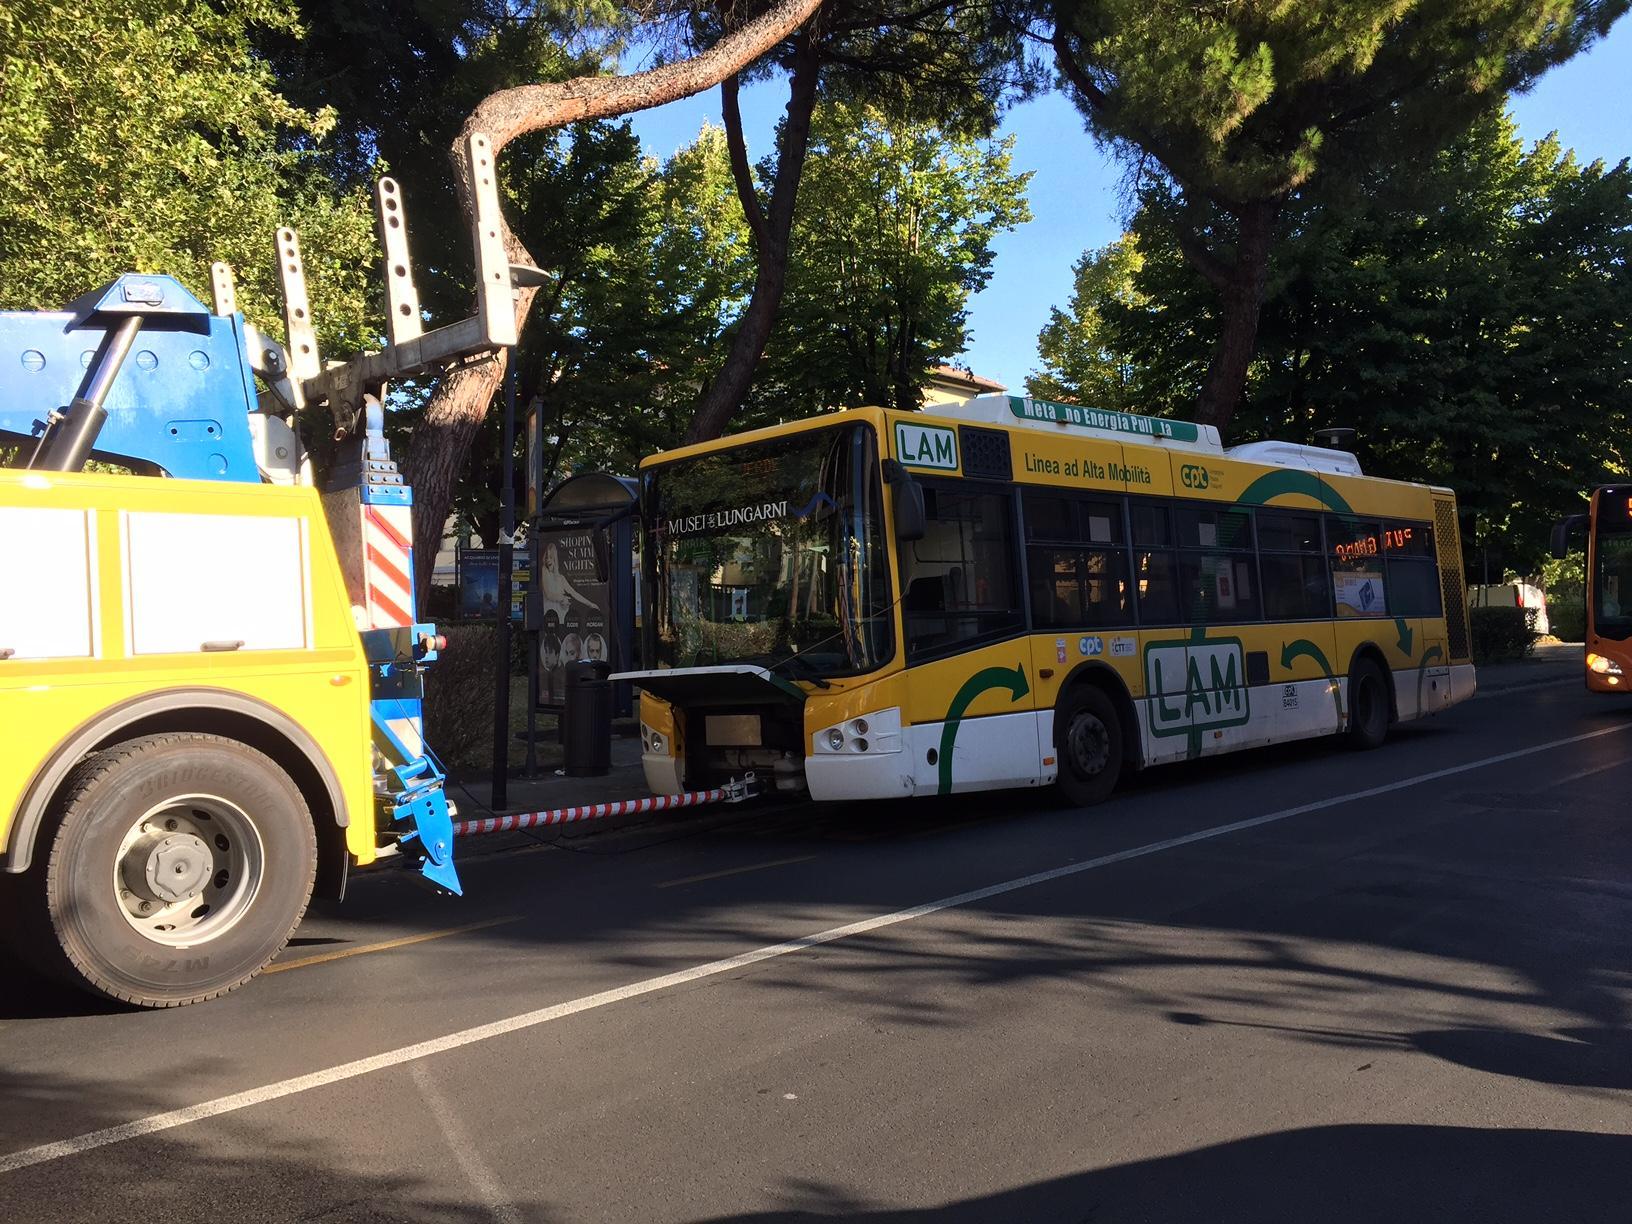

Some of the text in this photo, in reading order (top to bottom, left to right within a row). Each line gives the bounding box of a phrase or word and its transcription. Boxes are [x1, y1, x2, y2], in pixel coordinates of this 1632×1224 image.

[1022, 398, 1056, 420] Meta
[1065, 407, 1080, 423] no
[1083, 408, 1129, 431] Energia
[900, 428, 953, 464] LAM
[1025, 453, 1151, 485] Linea ad Alta Mobilità
[668, 514, 706, 535] MUSEI
[560, 535, 592, 548] SHOPIN
[563, 559, 594, 571] NIGHTS
[1079, 636, 1102, 655] cpt
[1154, 652, 1241, 722] LAM
